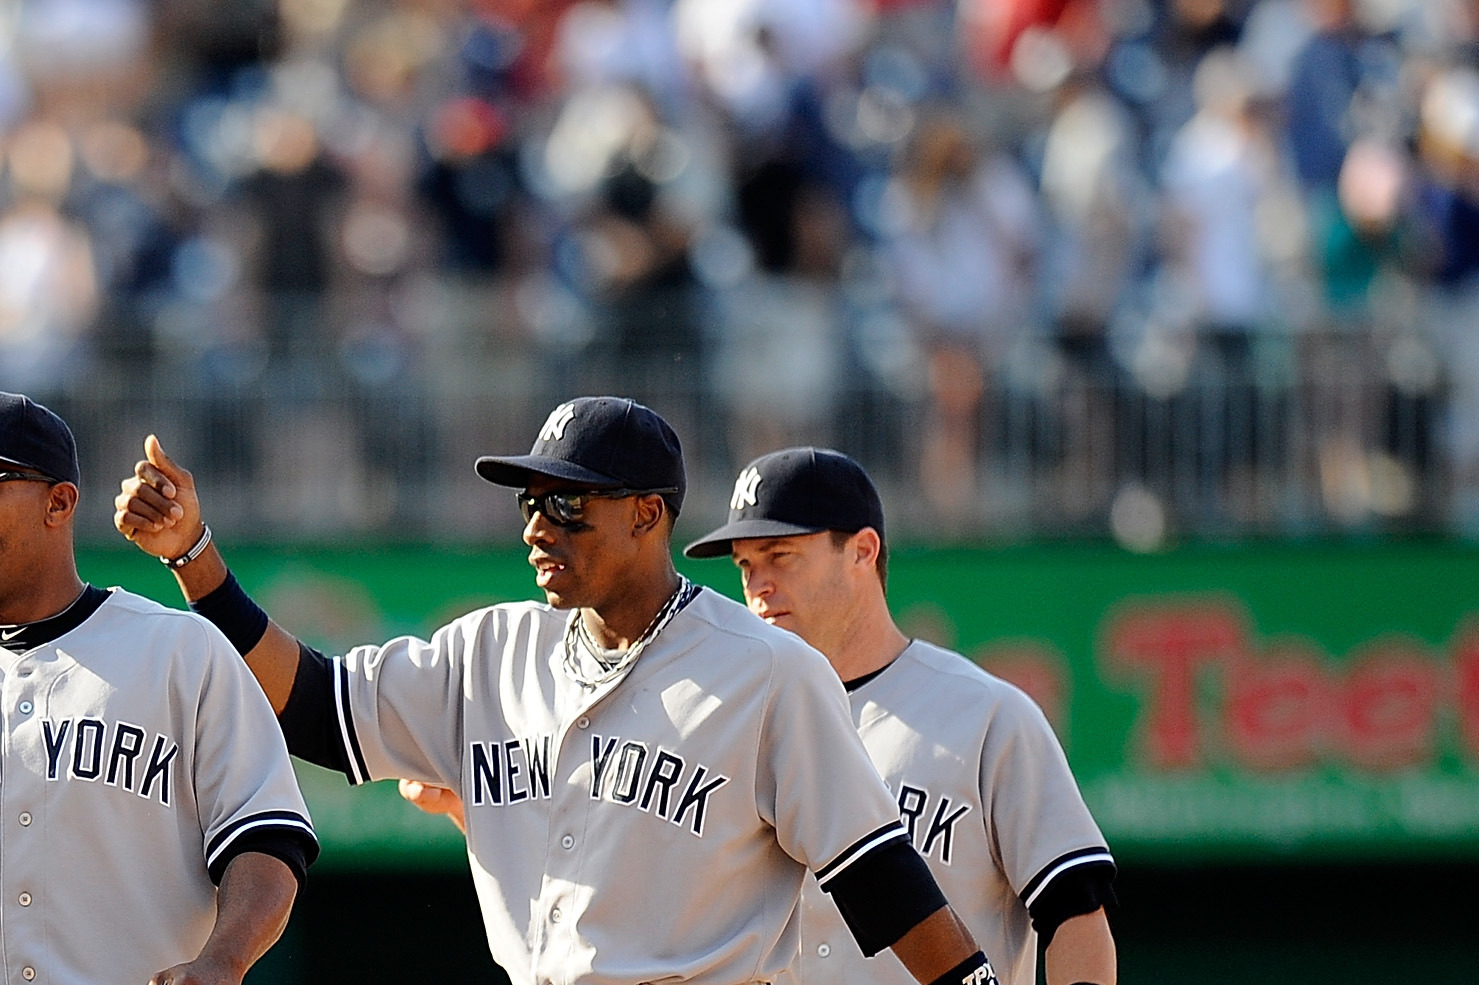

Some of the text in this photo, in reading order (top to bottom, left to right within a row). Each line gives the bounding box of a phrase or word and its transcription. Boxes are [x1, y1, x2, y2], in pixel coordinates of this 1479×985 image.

[38, 715, 179, 808] YORK
[470, 734, 731, 838] NEW YORK
[896, 779, 974, 867] RK
